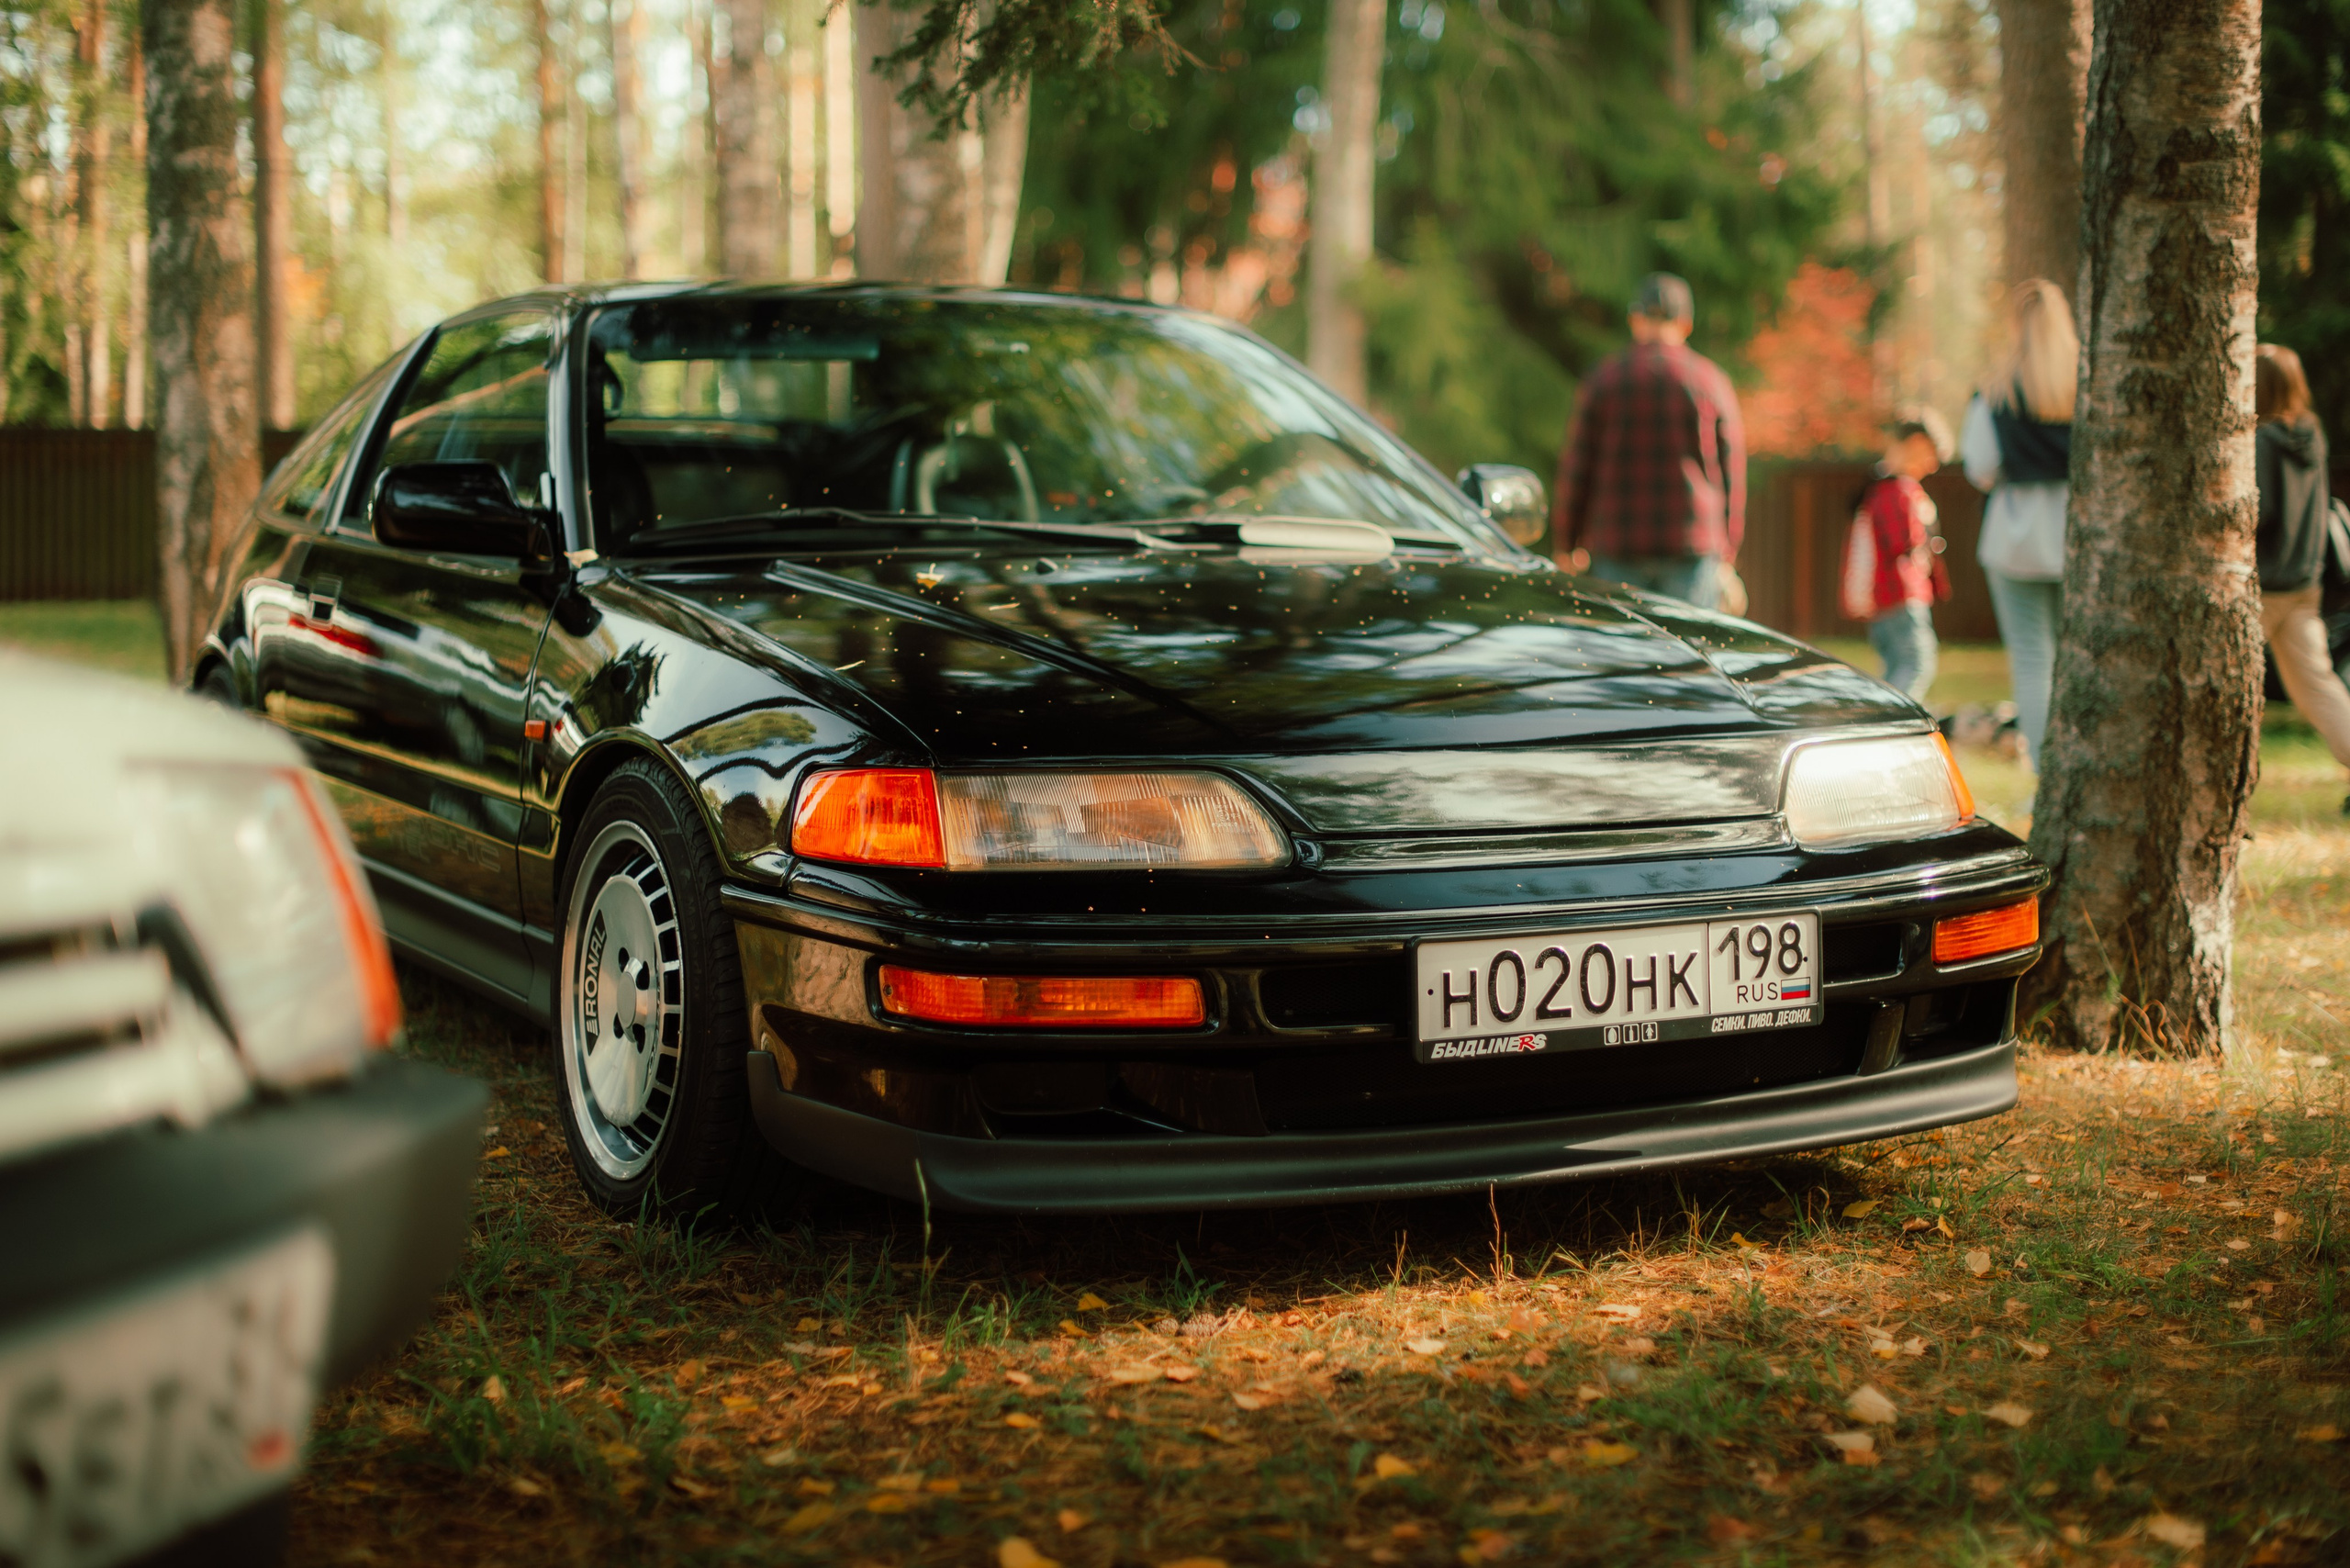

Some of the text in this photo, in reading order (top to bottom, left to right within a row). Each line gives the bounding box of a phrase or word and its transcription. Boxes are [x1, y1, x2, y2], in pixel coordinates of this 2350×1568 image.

[585, 927, 606, 1017] RONAL
[1717, 921, 1803, 981] 198
[1737, 982, 1778, 1004] RUS
